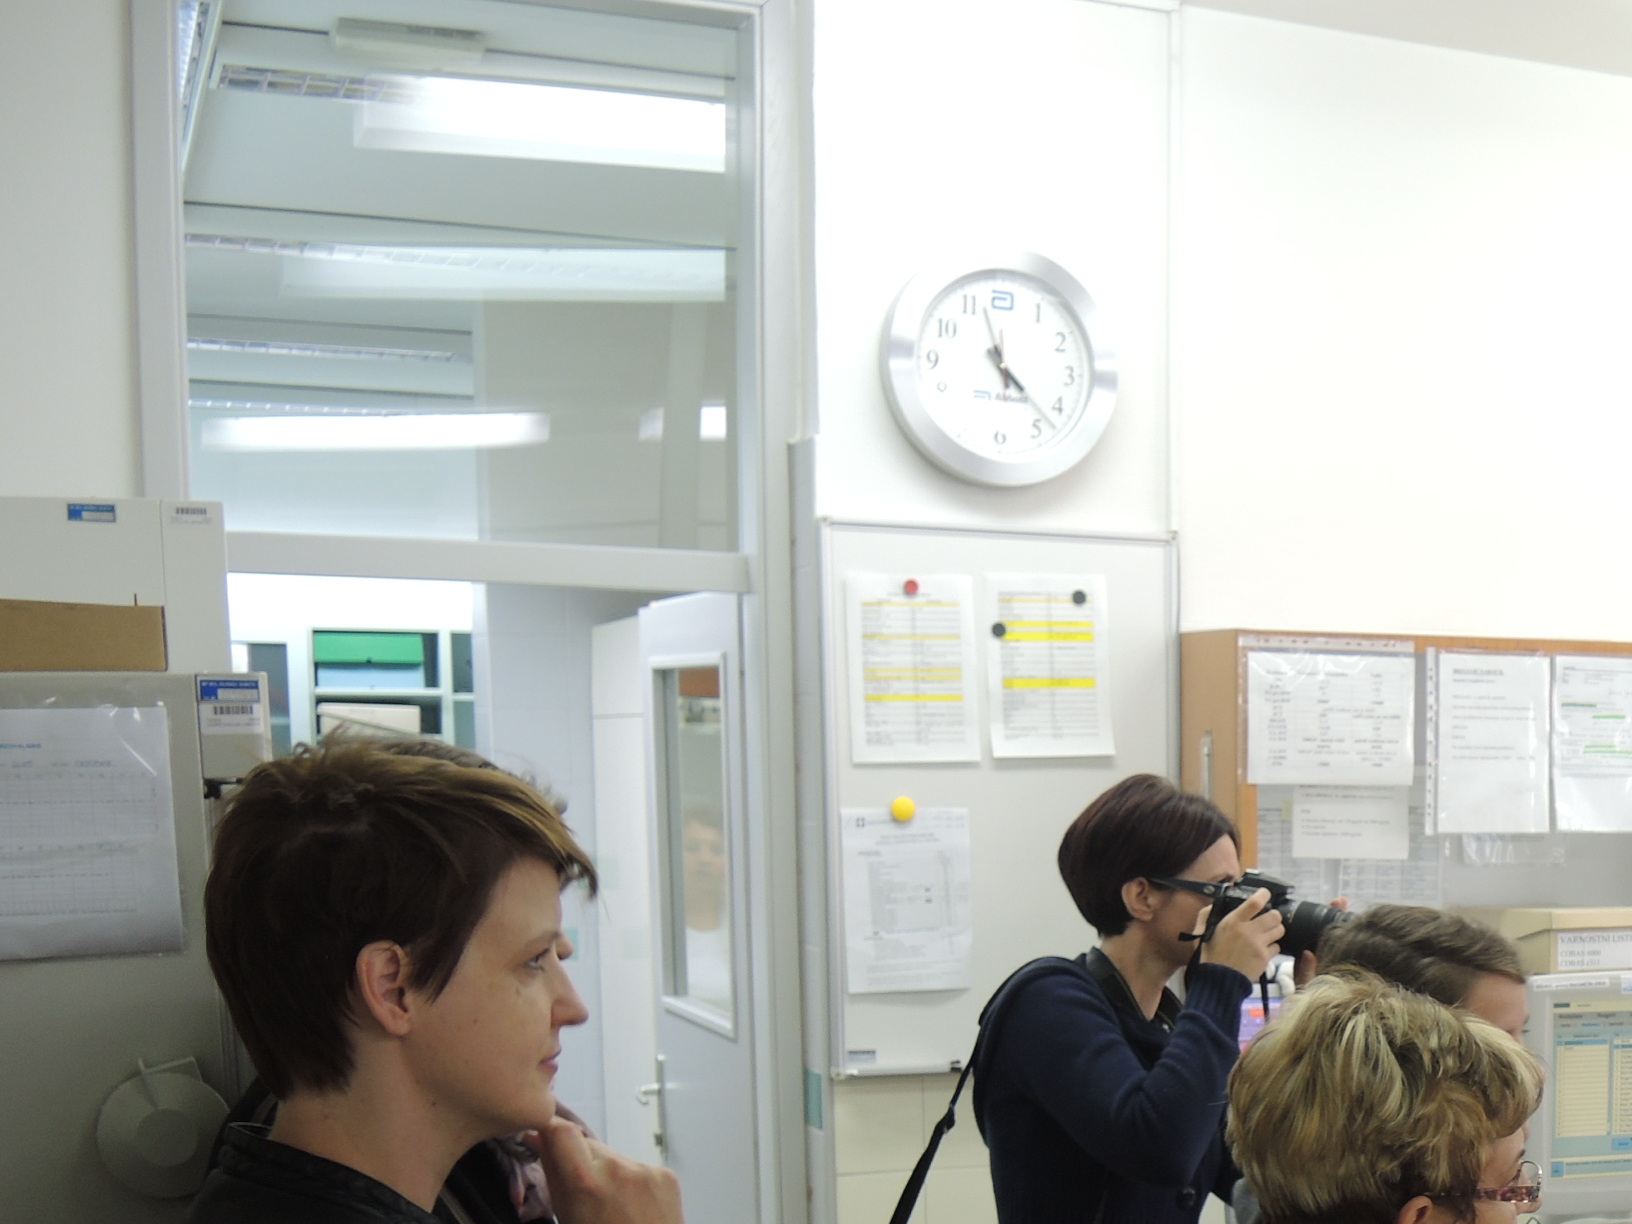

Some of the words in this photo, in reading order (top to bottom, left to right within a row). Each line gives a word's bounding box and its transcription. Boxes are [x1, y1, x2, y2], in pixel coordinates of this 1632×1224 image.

[961, 294, 977, 316] 11
[1034, 303, 1042, 323] 1
[937, 318, 957, 339] 10
[1054, 332, 1067, 353] 2
[926, 349, 939, 370] 9
[1064, 366, 1076, 387] 3
[1051, 396, 1065, 416] 4
[994, 429, 1007, 445] 6
[1030, 419, 1043, 440] 5
[1560, 935, 1610, 944] VARNOSTNI
[1613, 934, 1632, 942] LISTI
